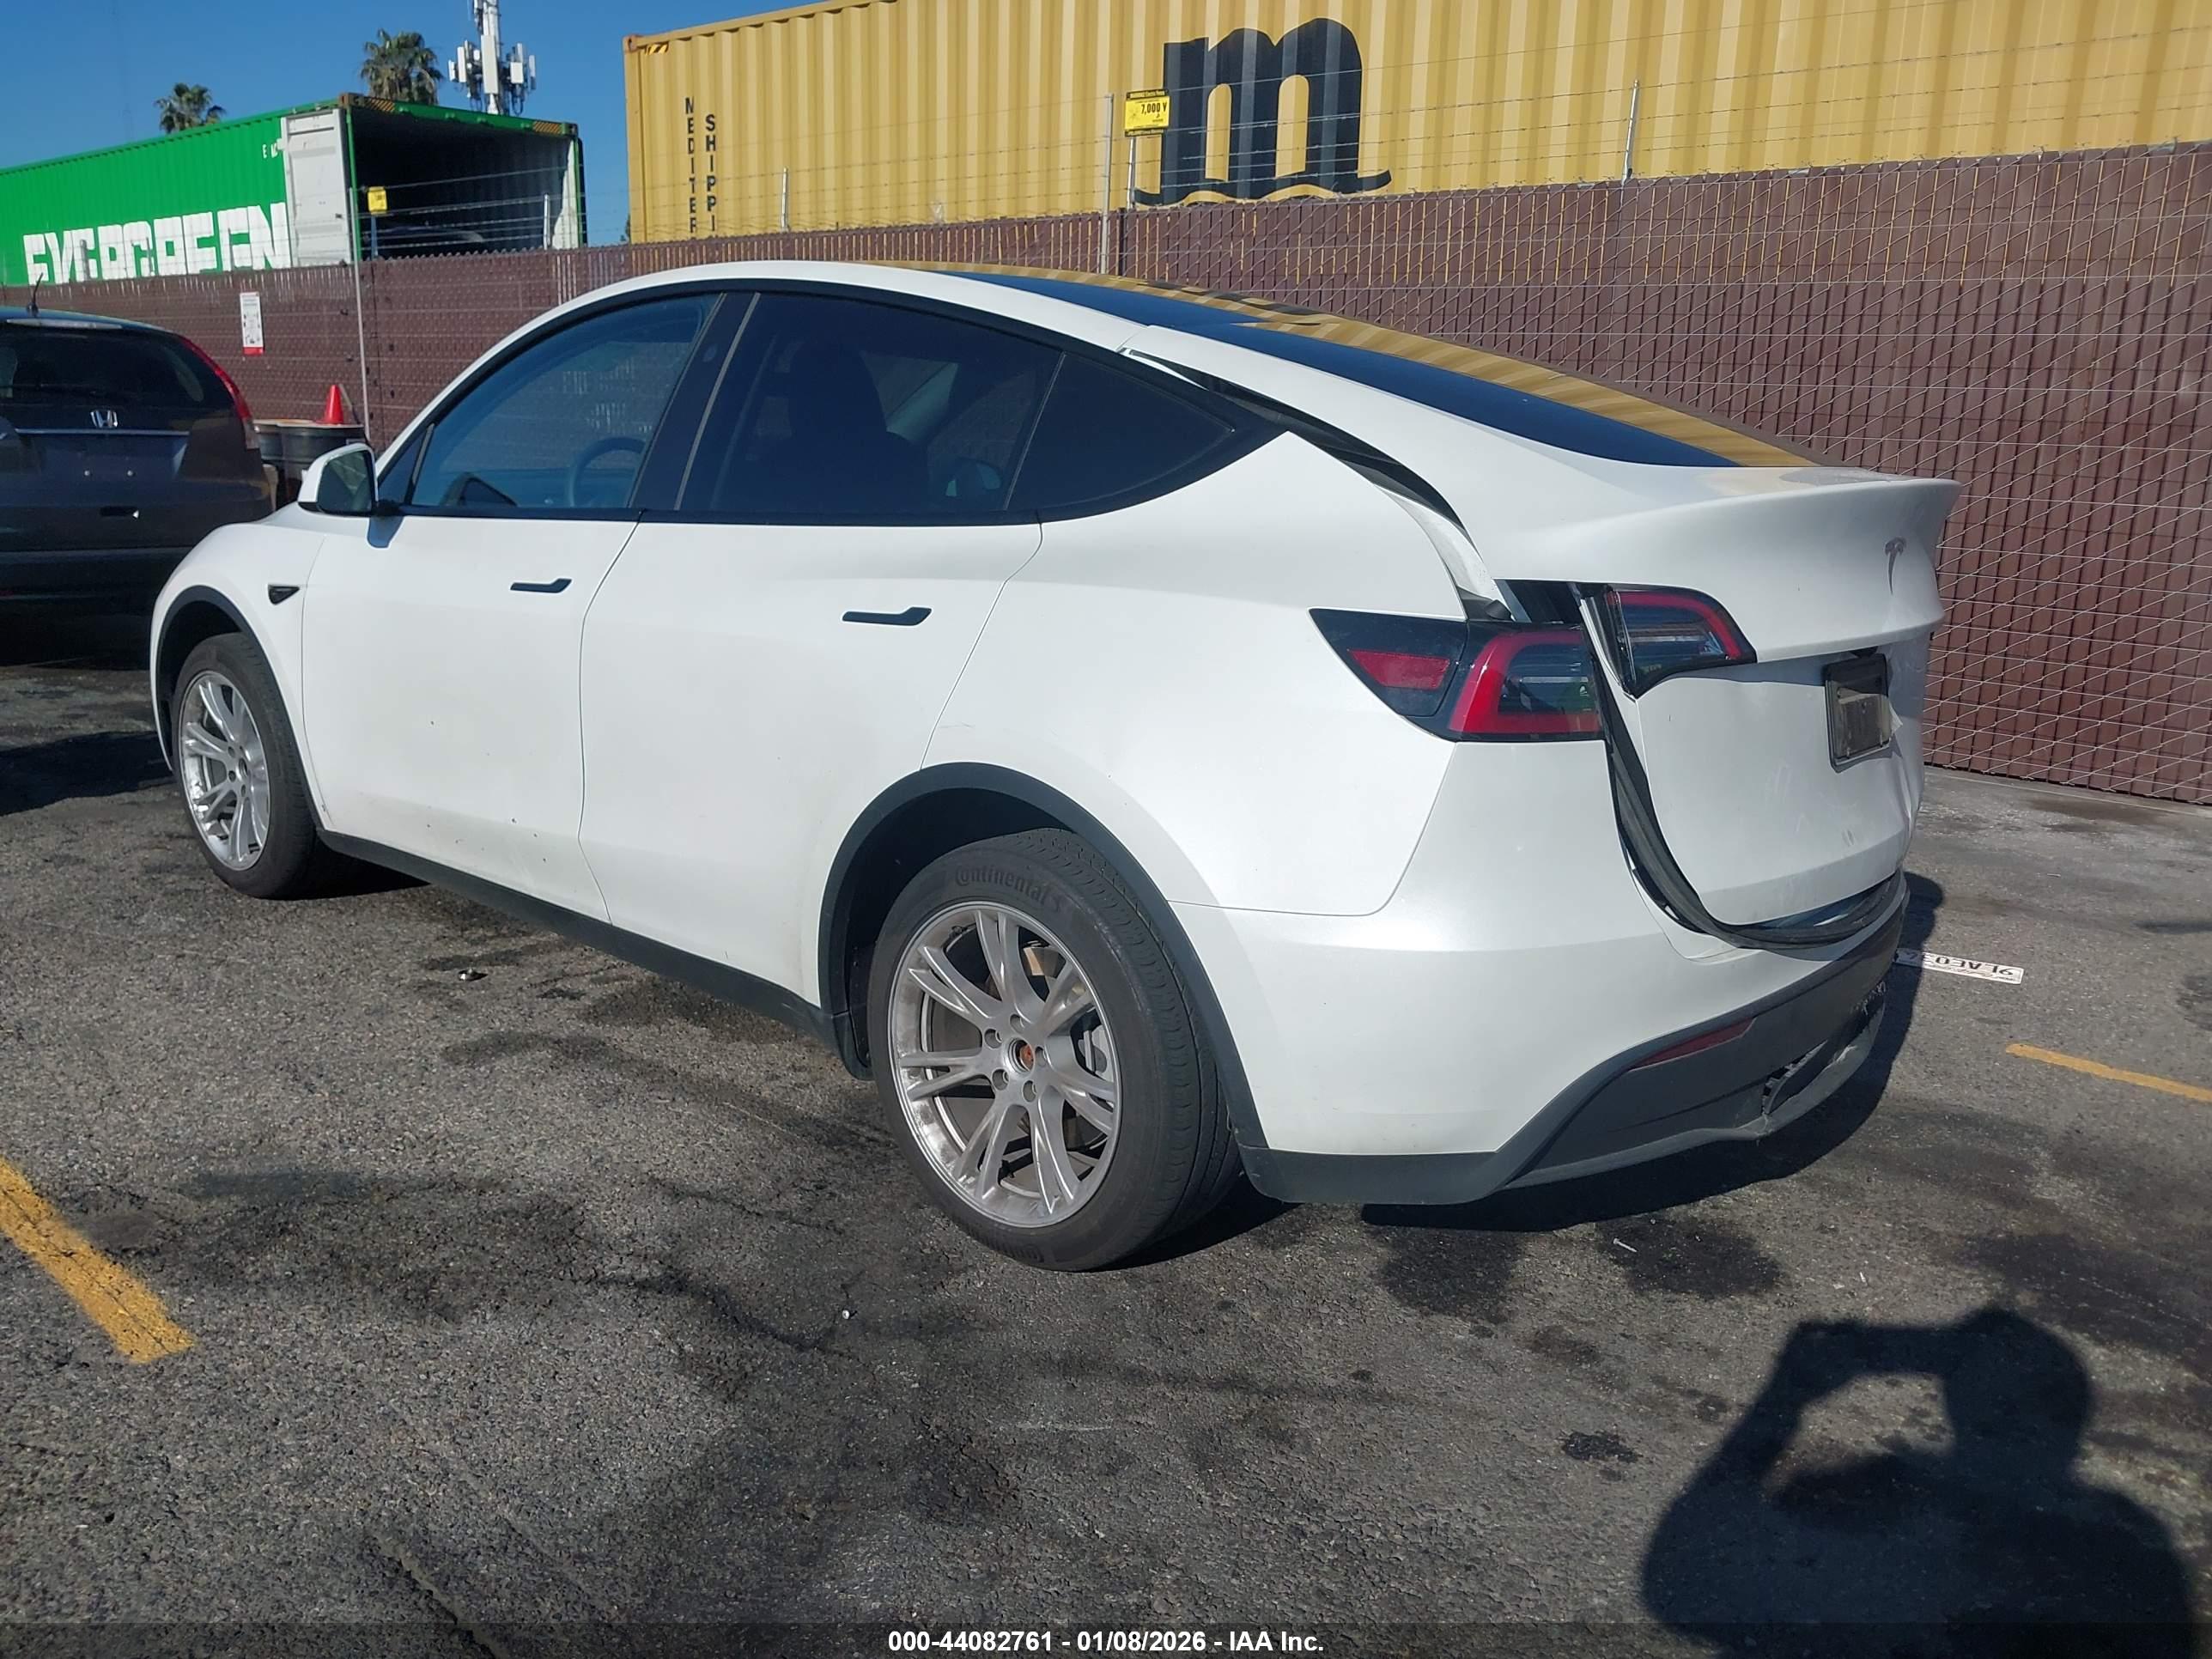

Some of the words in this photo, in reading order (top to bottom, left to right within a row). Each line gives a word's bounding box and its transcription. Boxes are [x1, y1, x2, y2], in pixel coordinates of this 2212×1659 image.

[1141, 102, 1160, 115] 7,000
[1162, 102, 1167, 112] V
[23, 202, 292, 284] EVERGREEN
[955, 865, 1049, 905] Continental
